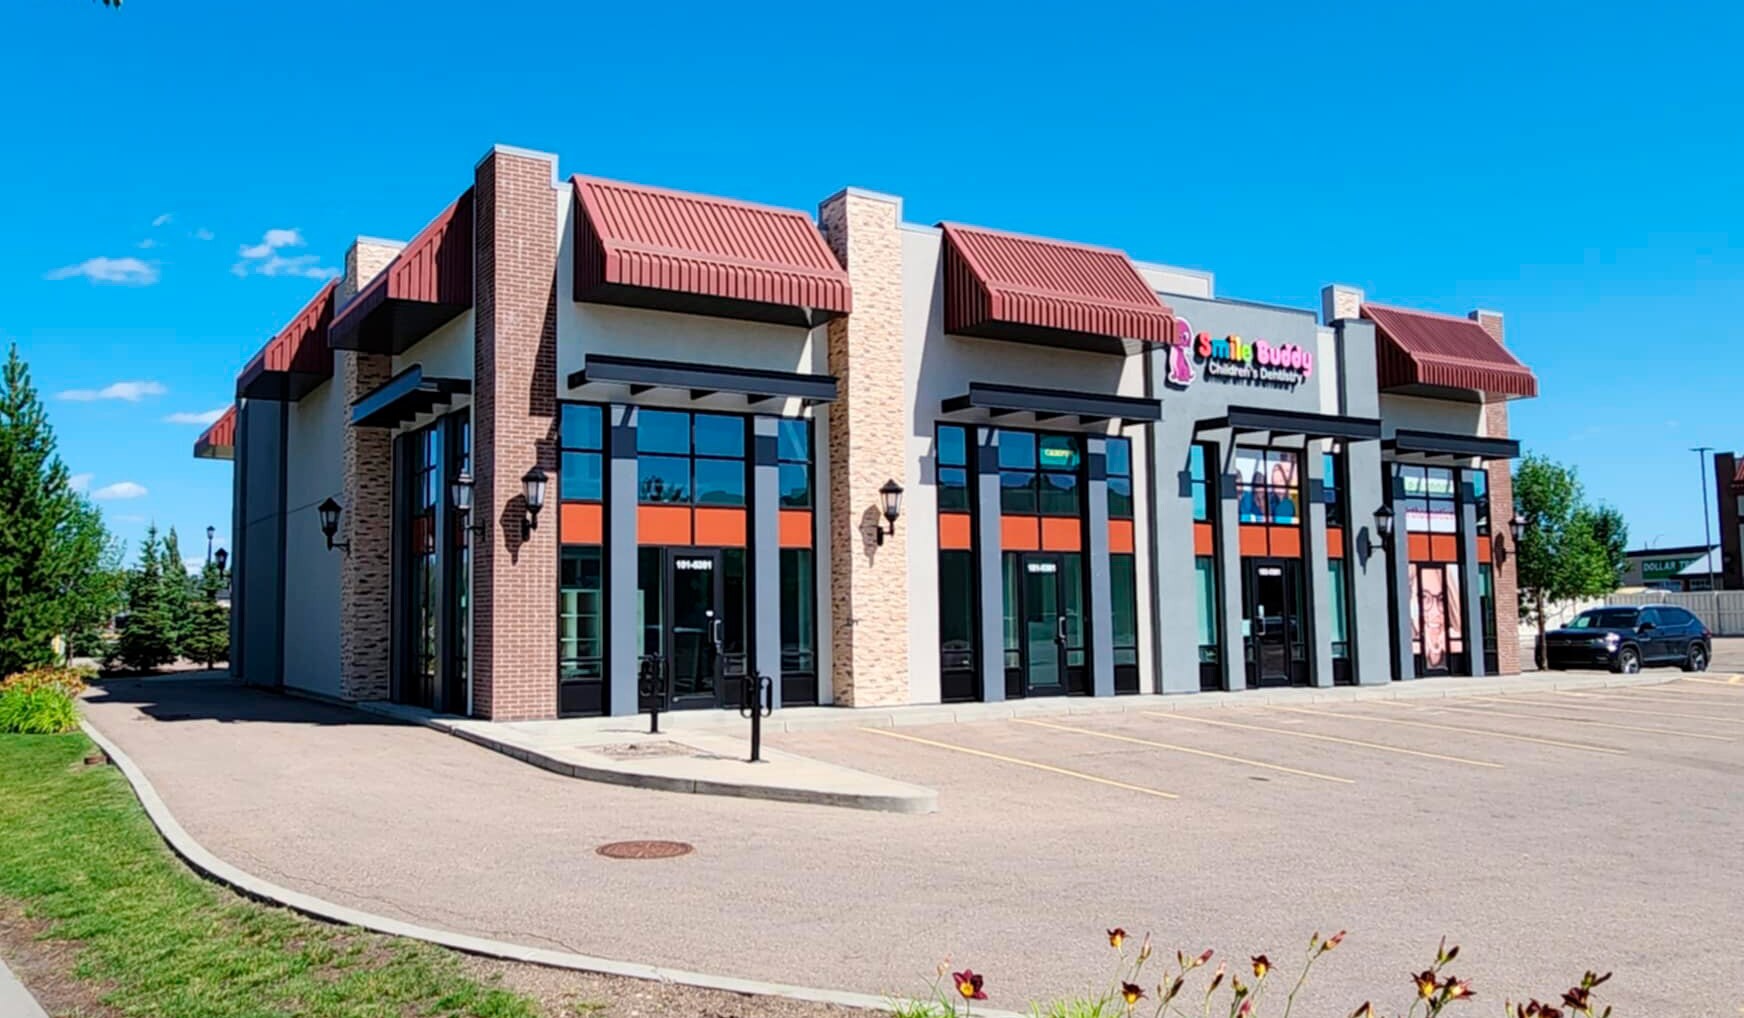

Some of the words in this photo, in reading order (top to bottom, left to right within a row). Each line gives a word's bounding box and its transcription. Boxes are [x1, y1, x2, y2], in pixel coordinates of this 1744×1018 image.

[1198, 331, 1253, 362] Smile
[1256, 339, 1312, 378] Buddy
[1208, 361, 1259, 379] Children's
[1260, 366, 1303, 383] Dentistry
[1643, 560, 1676, 572] DOLLAR
